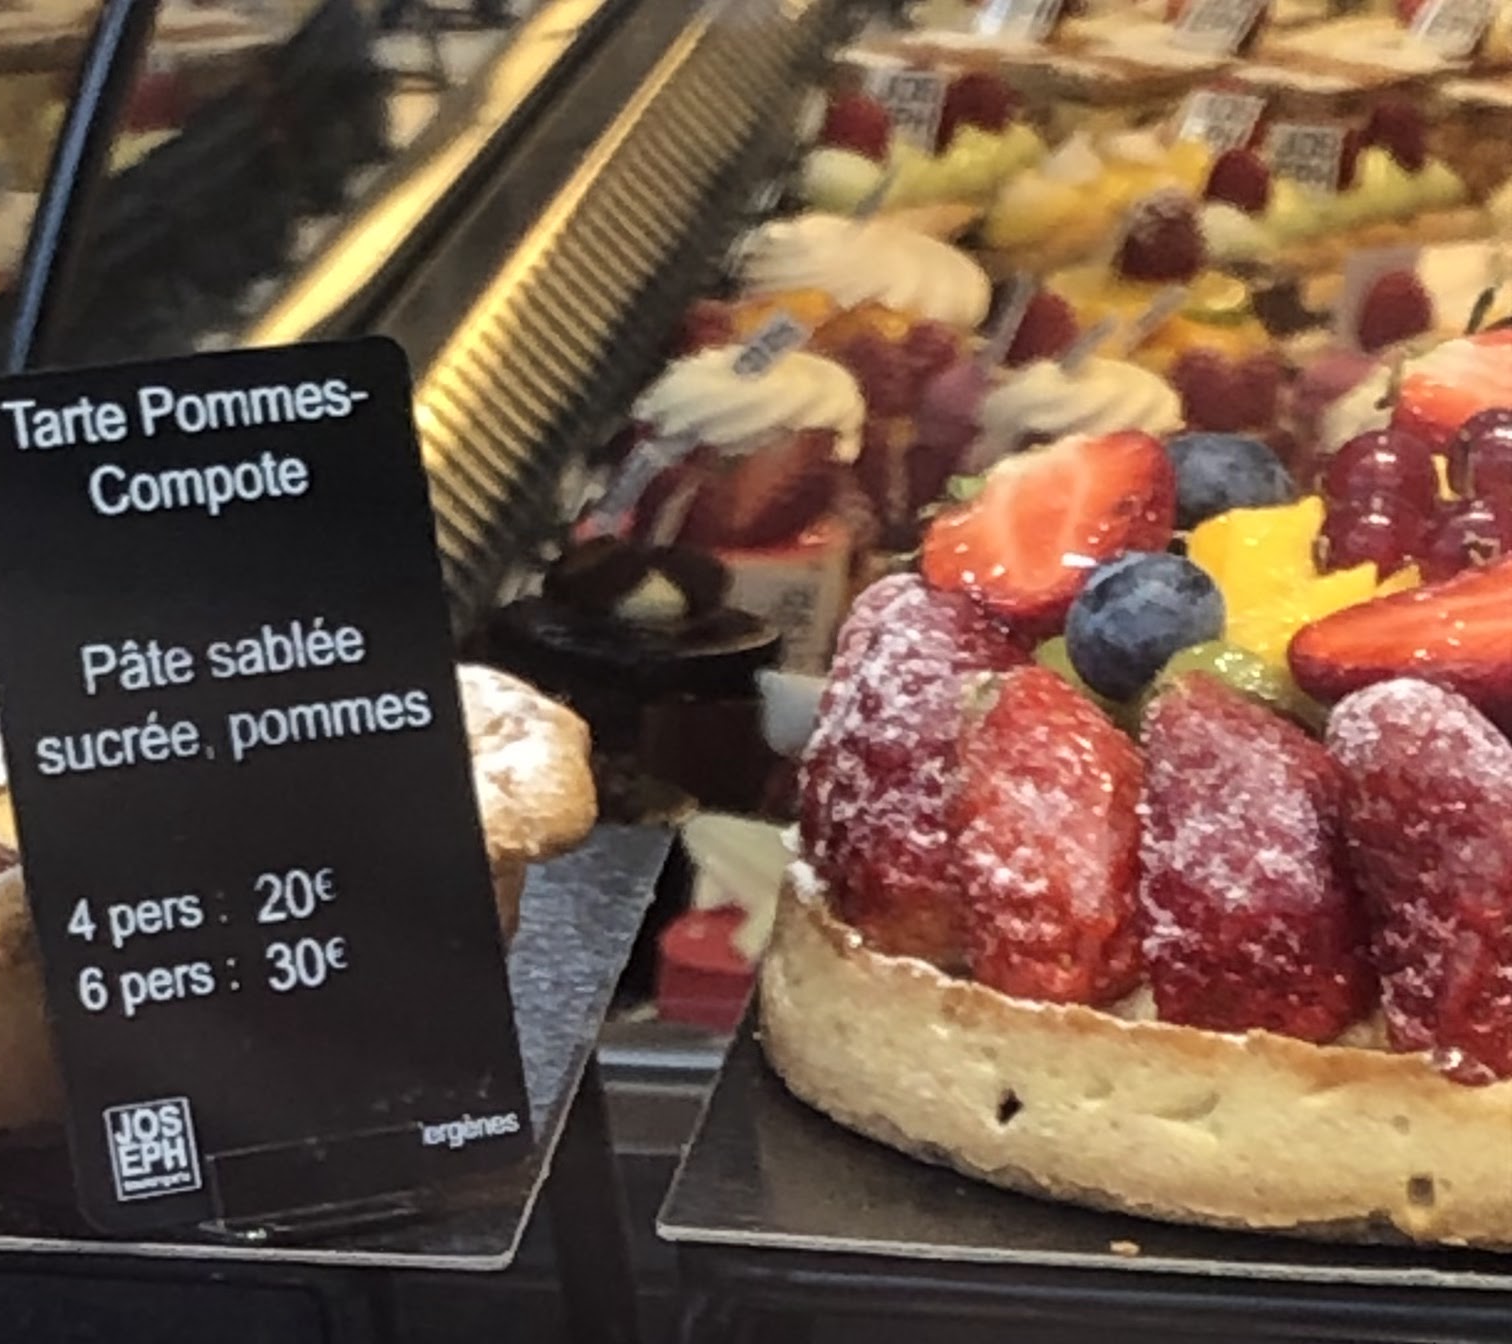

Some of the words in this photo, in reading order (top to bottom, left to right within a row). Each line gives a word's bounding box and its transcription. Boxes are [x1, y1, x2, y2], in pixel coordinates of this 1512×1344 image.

[0, 397, 129, 449] Tarte
[137, 377, 370, 437] Pommes-
[88, 450, 310, 516] Compote
[80, 638, 196, 695] Pâte
[206, 616, 365, 679] sablée
[228, 690, 434, 762] pommes
[67, 898, 97, 941] 4
[107, 894, 205, 948] pers
[254, 867, 337, 924] 20€
[78, 966, 109, 1011] 6
[119, 961, 216, 1017] pers
[265, 937, 349, 991] 30€
[114, 1104, 183, 1144] JOS
[119, 1136, 189, 1177] EPH
